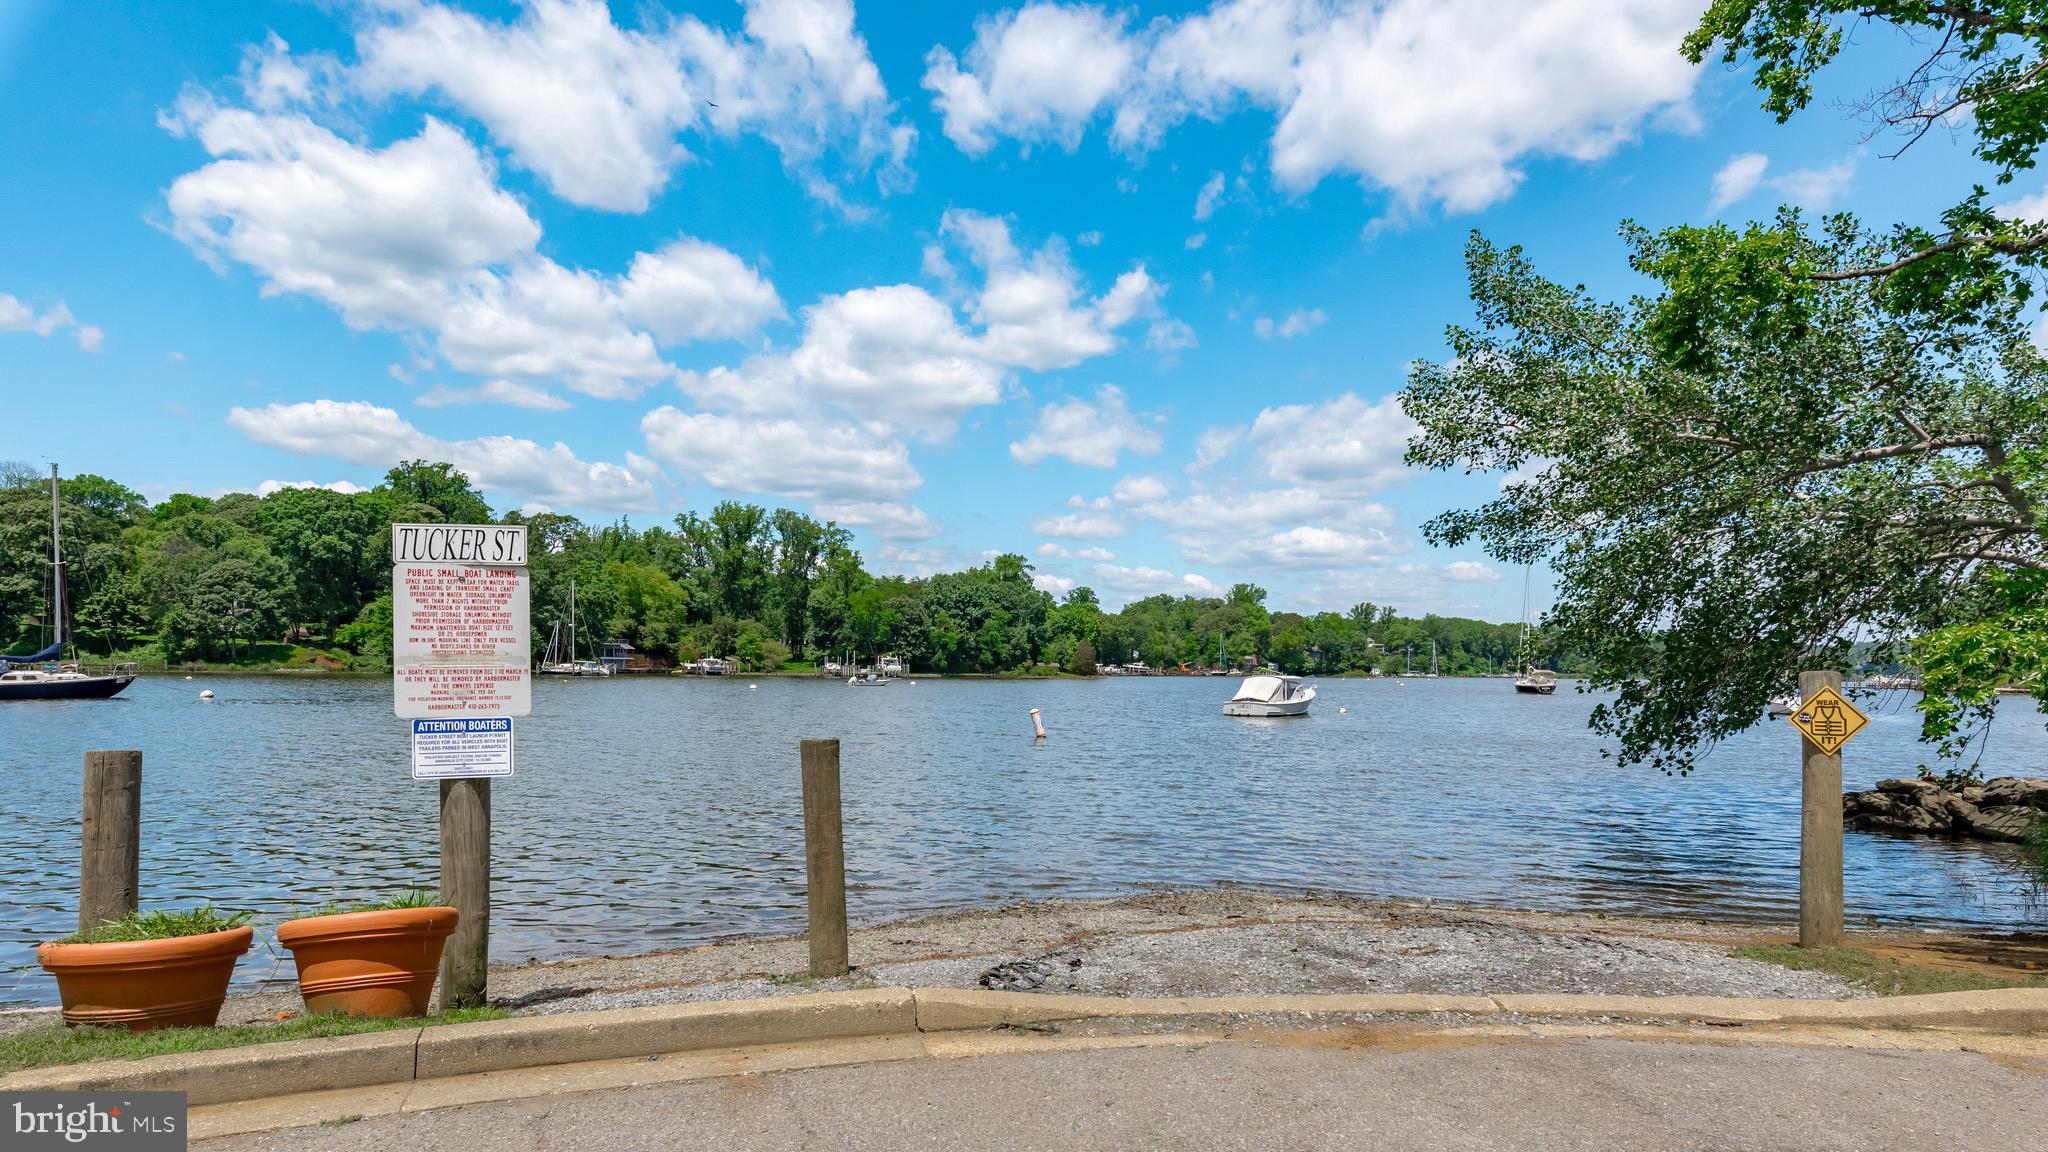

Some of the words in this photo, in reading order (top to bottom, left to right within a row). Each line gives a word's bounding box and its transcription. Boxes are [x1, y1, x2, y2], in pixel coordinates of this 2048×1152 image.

[400, 528, 486, 560] TUCKER
[492, 530, 521, 562] ST.
[408, 569, 433, 577] PUBLIC
[437, 569, 459, 577] SMALL
[464, 569, 482, 578] BOAT
[486, 570, 517, 578] LANDING
[418, 721, 466, 731] ATTENTION
[469, 720, 508, 731] BOATERS
